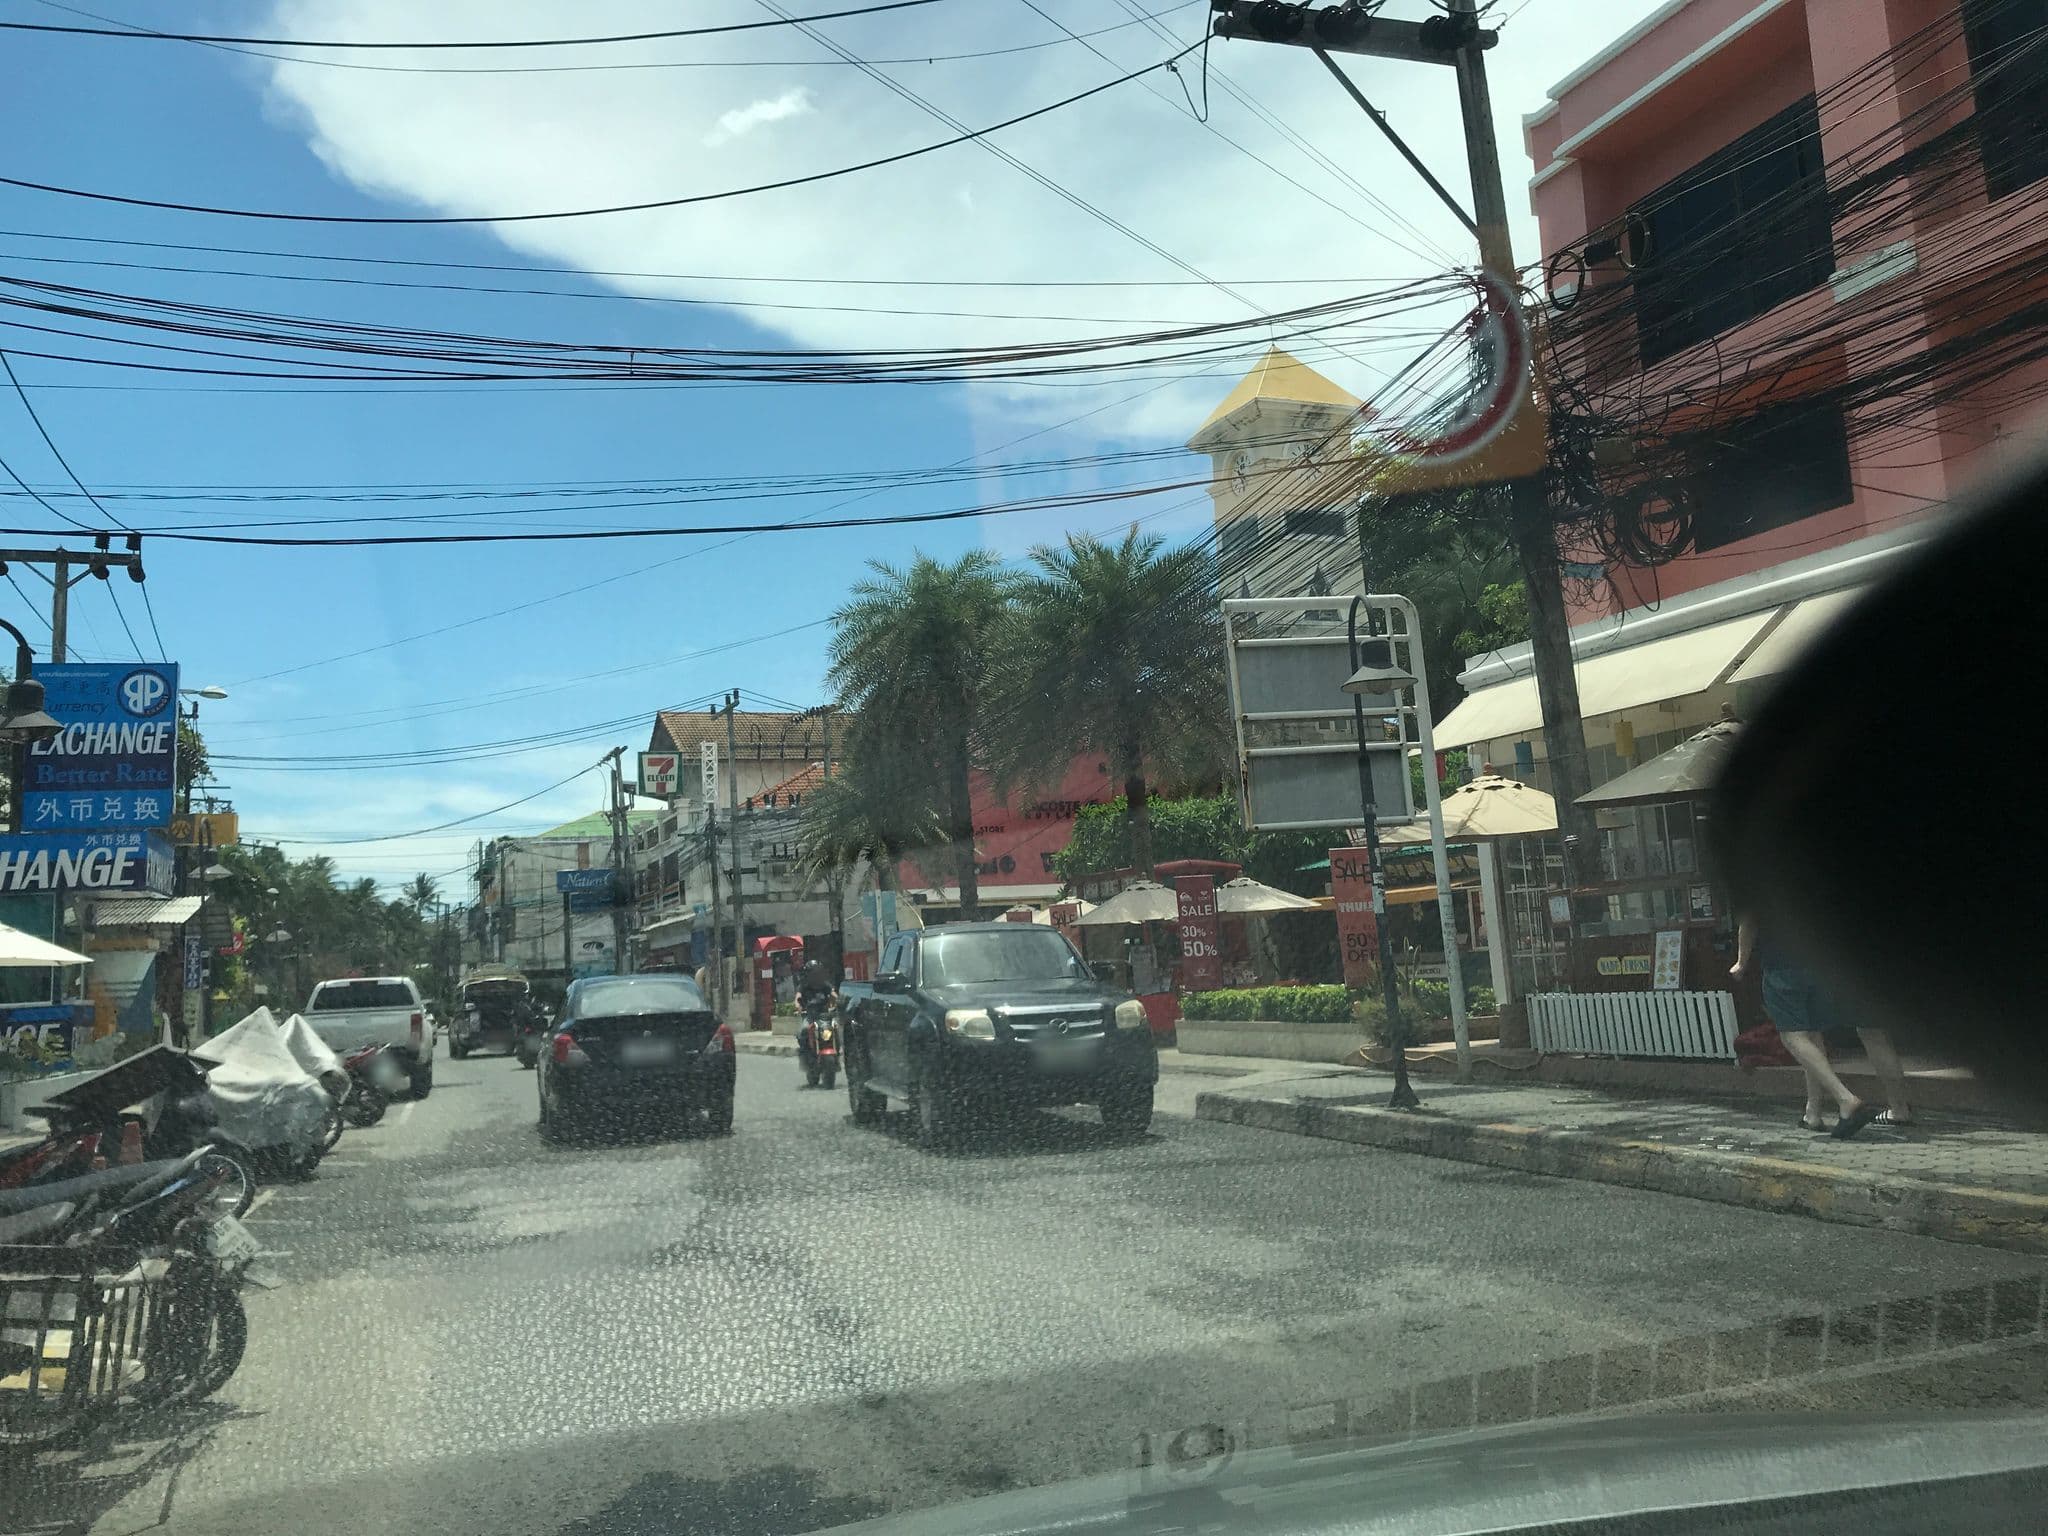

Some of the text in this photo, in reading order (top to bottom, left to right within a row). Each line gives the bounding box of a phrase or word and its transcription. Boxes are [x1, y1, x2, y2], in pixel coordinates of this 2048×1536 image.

[46, 702, 110, 716] urrency
[36, 762, 168, 784] Better Rate
[647, 757, 675, 794] 7
[36, 797, 160, 823] 外币兑换
[86, 834, 141, 846] 外币兑换
[1181, 904, 1213, 917] SALE
[1182, 925, 1206, 938] 30%
[1184, 940, 1217, 957] 50%
